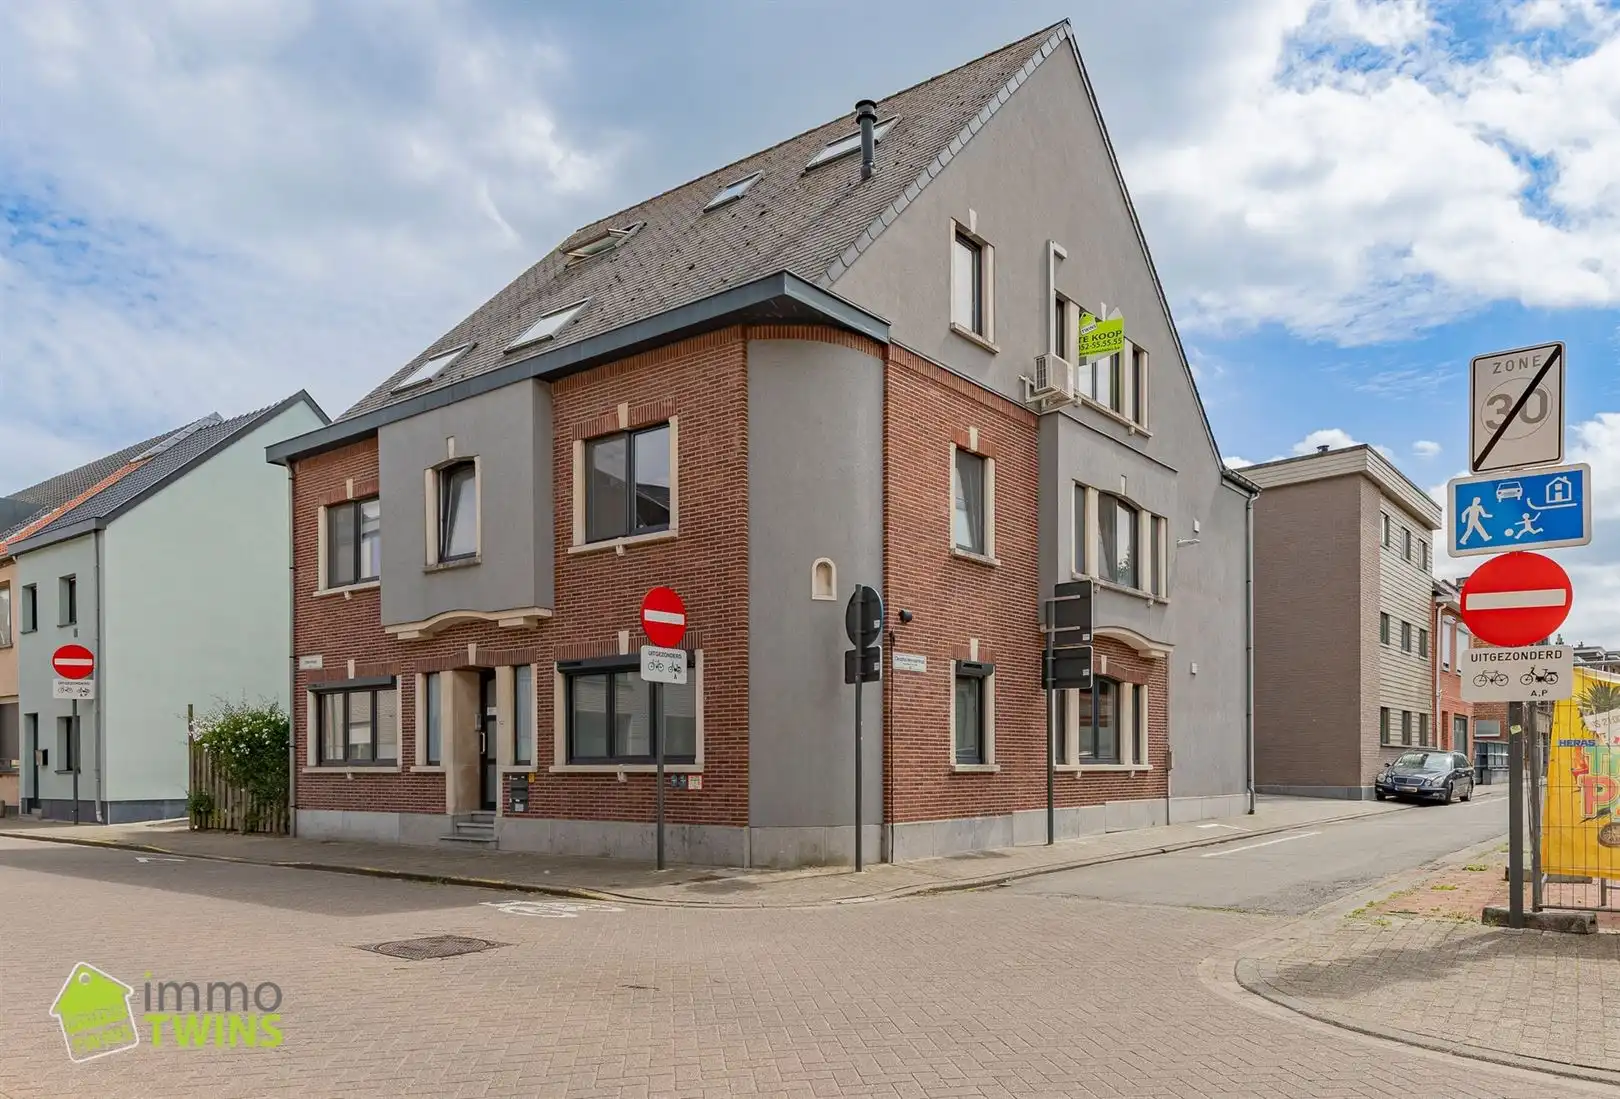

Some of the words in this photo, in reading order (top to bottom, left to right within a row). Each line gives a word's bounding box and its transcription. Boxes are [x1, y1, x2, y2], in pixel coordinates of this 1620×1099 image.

[1091, 330, 1122, 341] KOOP
[1079, 338, 1122, 351] 52-55.55.55
[1492, 354, 1542, 374] ZONE
[1485, 387, 1549, 431] 30
[1470, 650, 1563, 663] UITGEZONDERD
